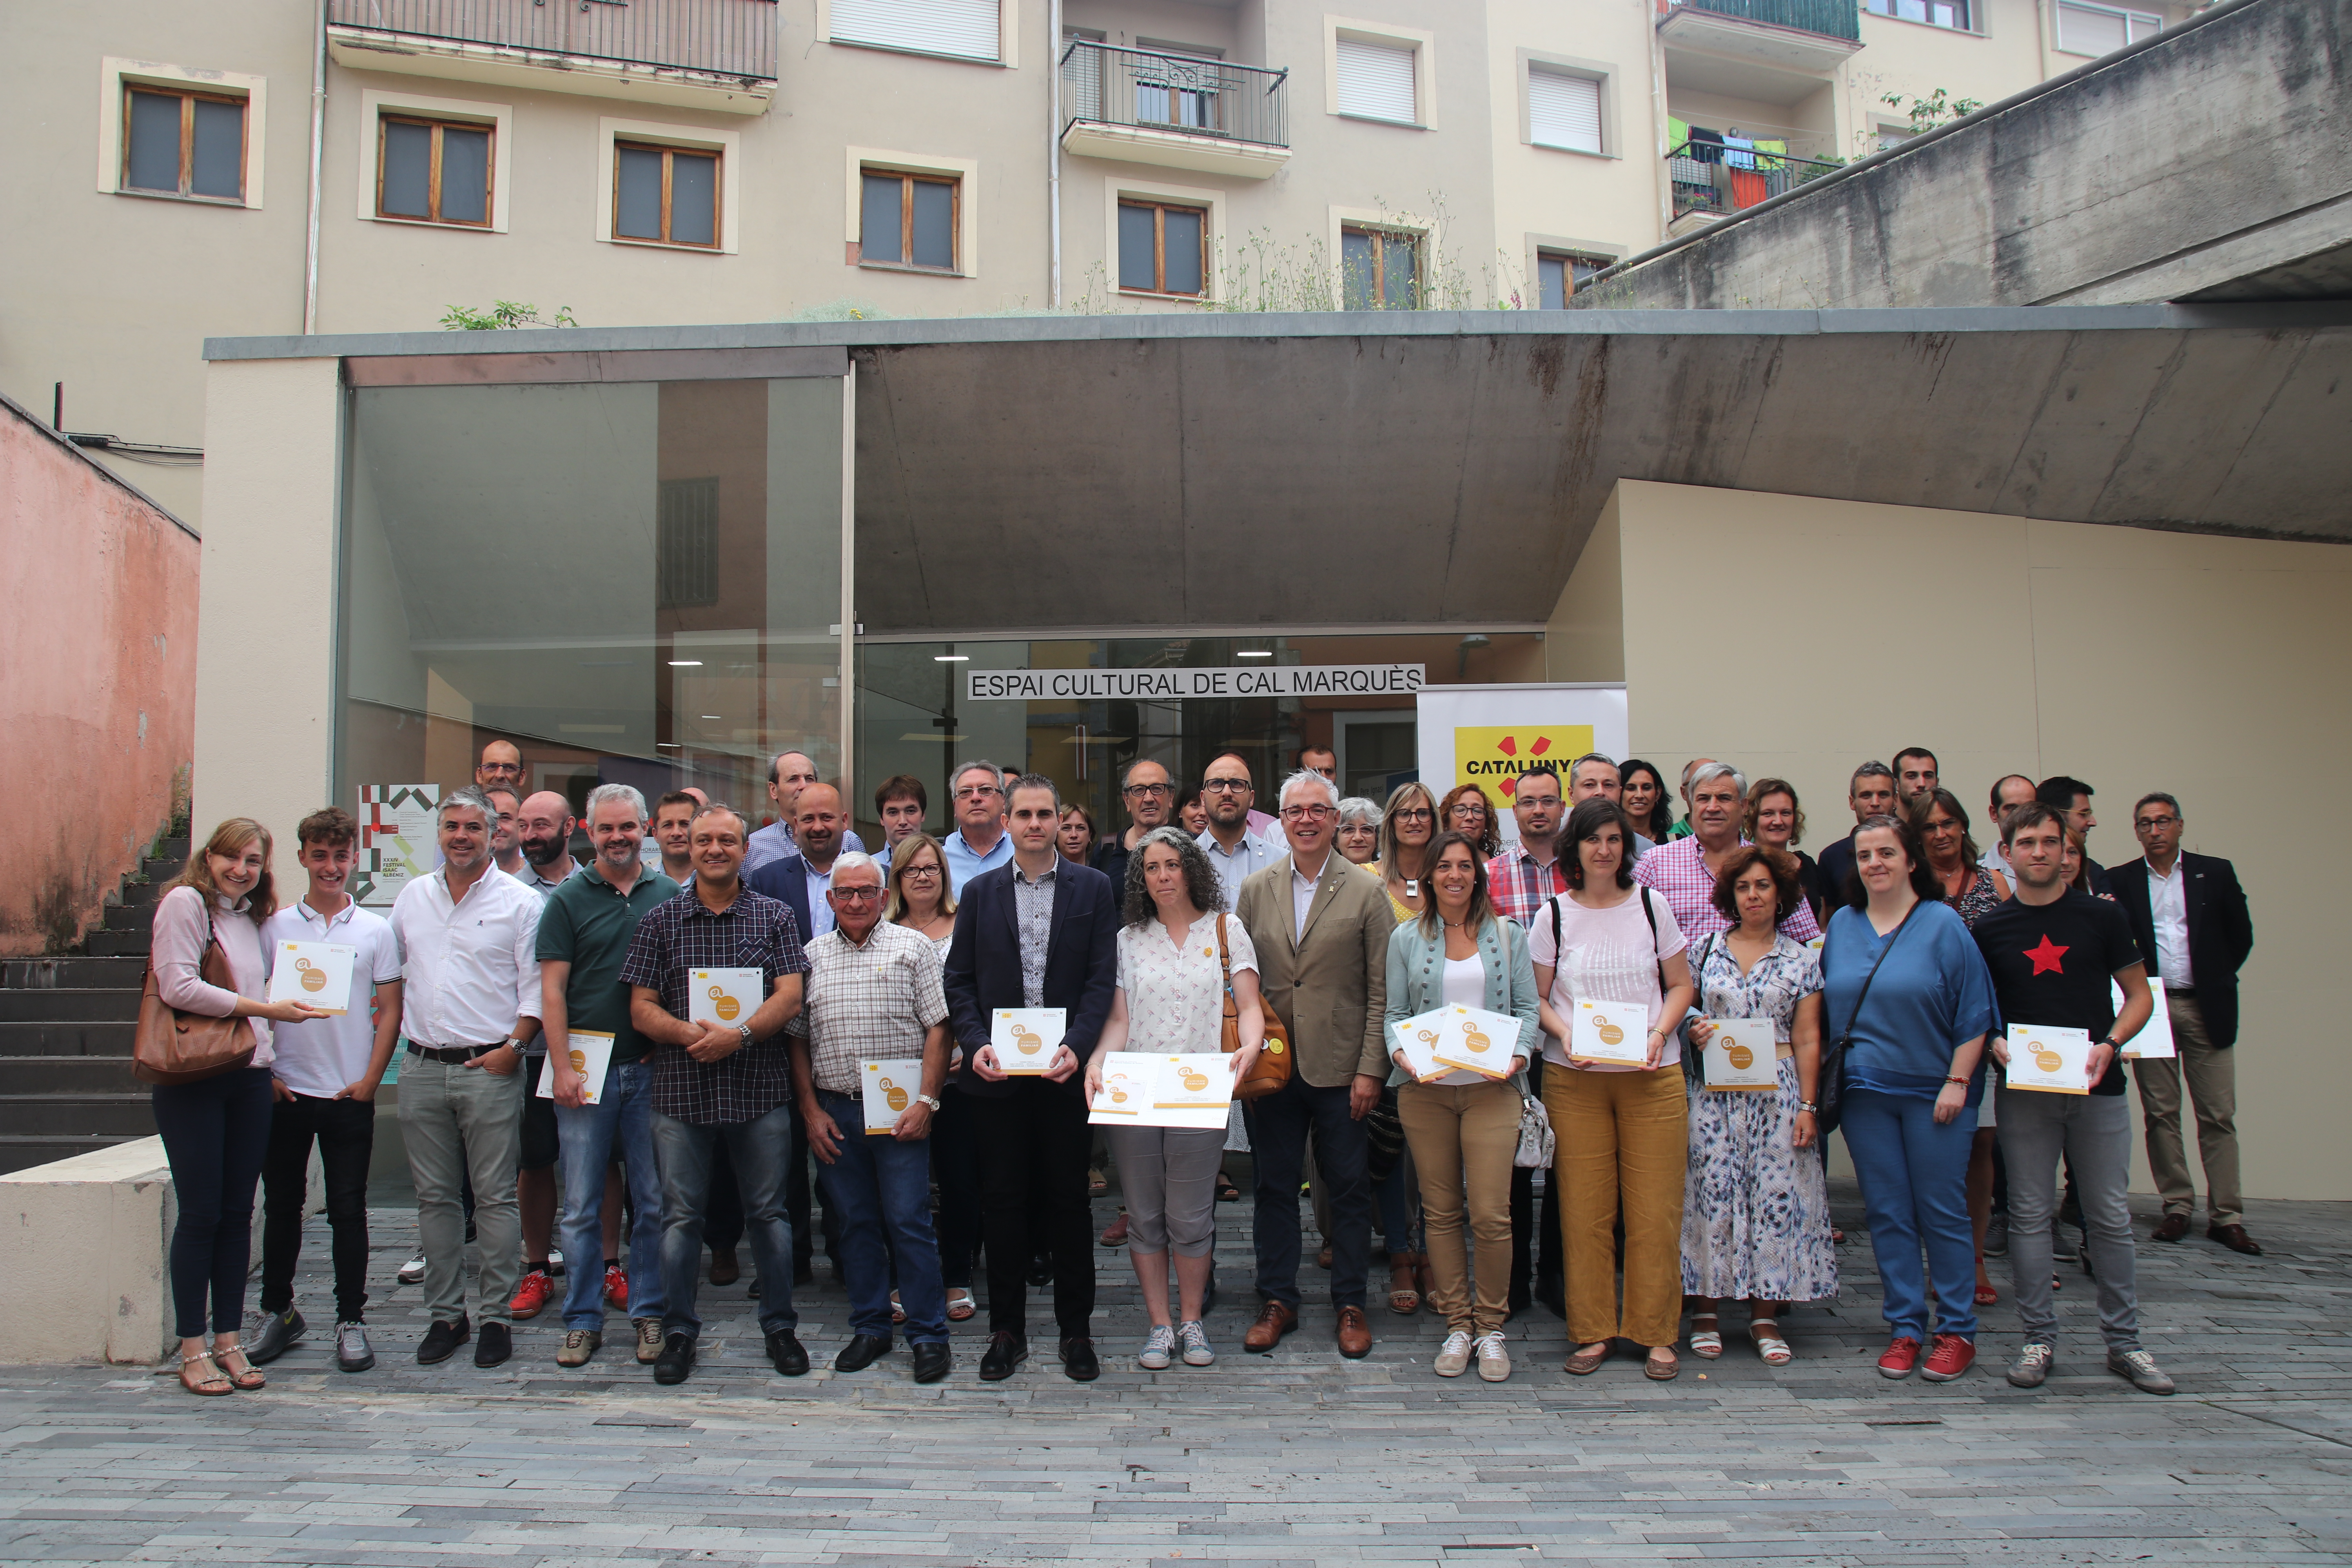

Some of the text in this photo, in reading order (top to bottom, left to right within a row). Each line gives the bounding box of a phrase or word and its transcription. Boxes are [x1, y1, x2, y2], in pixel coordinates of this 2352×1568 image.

[972, 665, 1421, 696] ESPAI CULTURAL DE CAL MARQUÈS
[1466, 759, 1578, 774] CATALUNY
[1371, 784, 1384, 796] Ignasi
